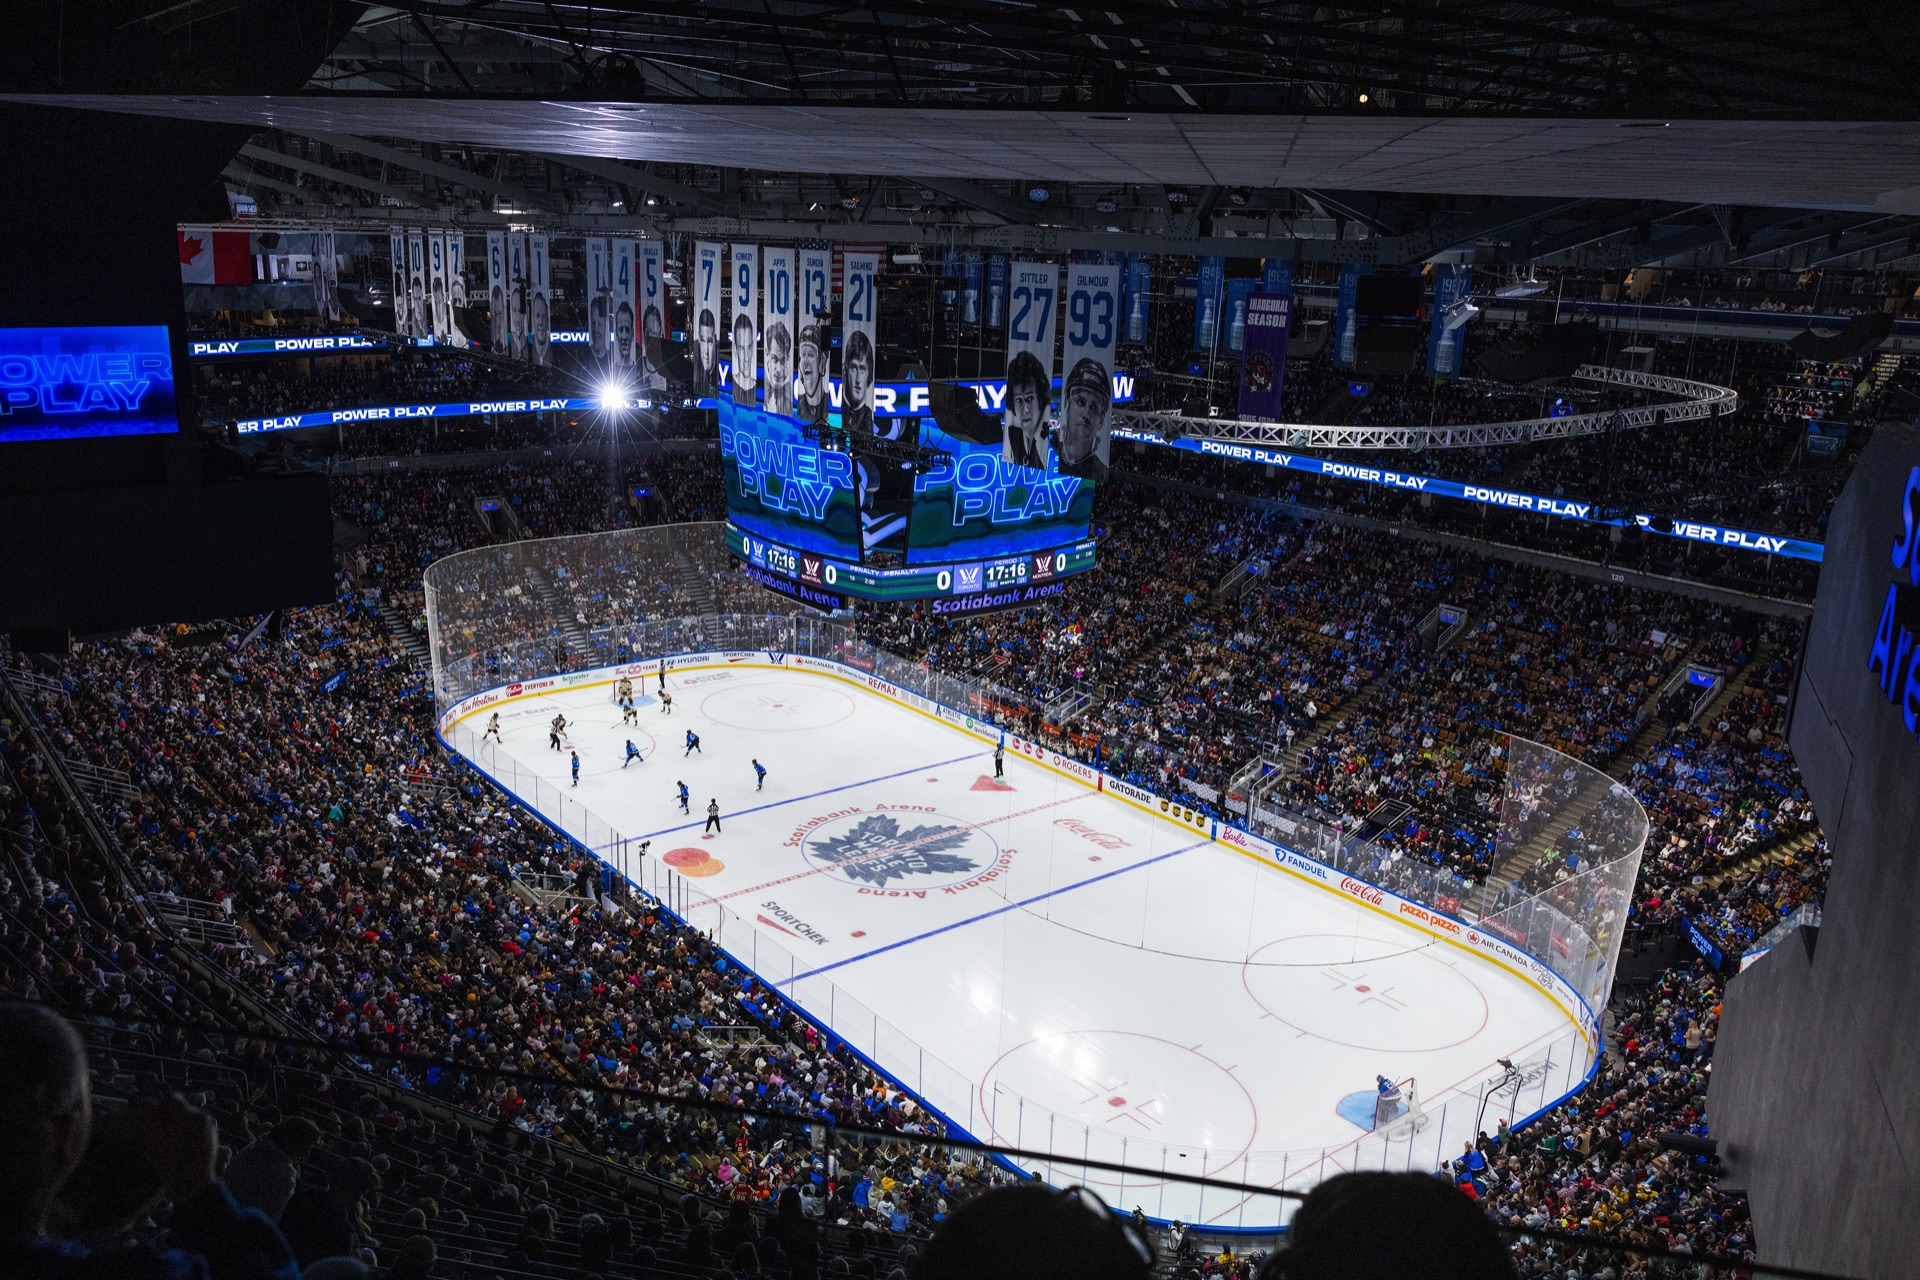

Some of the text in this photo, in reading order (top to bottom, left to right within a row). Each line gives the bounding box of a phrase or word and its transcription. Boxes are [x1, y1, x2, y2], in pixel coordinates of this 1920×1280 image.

[393, 238, 402, 265] 14
[411, 242, 421, 272] 10
[433, 241, 441, 272] 9
[451, 244, 459, 275] 7
[513, 248, 520, 278] 4
[735, 250, 753, 262] KENNEDY
[773, 258, 786, 268] APPS
[806, 258, 824, 268] SUNDIN
[492, 247, 501, 280] 6
[536, 251, 542, 286] 1
[594, 253, 600, 286] 1
[850, 261, 873, 272] SALMING
[618, 256, 629, 295] 4
[646, 259, 657, 297] 5
[702, 259, 713, 302] 7
[738, 263, 750, 307] 9
[1020, 272, 1048, 285] SITTLER
[1077, 276, 1109, 287] GILMOUR
[769, 270, 789, 315] 10
[804, 270, 825, 315] 13
[848, 273, 872, 323] 21
[1010, 286, 1053, 342] 27
[1249, 297, 1289, 313] INAUGURAL
[1068, 290, 1114, 348] 93
[1247, 313, 1287, 328] SEASON
[194, 342, 239, 354] PLAY
[275, 338, 334, 350] POWER
[338, 336, 376, 348] PLA
[0, 381, 150, 415] PLAY
[263, 416, 302, 430] PLAY
[332, 408, 390, 422] POWER
[394, 406, 436, 418] PLAY
[469, 401, 528, 414] POWER
[530, 399, 569, 411] PLAY
[718, 424, 854, 488] POWER
[738, 464, 833, 519] PLAY
[953, 477, 1082, 526] PLAY
[1202, 441, 1252, 461] POWER
[1254, 451, 1292, 467] PLAY
[1321, 461, 1381, 481] POWER
[1384, 471, 1428, 490] PLAY
[1463, 485, 1533, 511] POWER
[1536, 498, 1590, 521] PLAY
[1634, 515, 1717, 541] PWER
[1723, 530, 1787, 552] PLAY
[1389, 527, 1399, 536] 119
[743, 536, 750, 555] 0
[771, 543, 788, 553] PERIOD
[1075, 541, 1095, 551] PENALTY
[767, 549, 796, 570] 17:16
[849, 564, 880, 577] PENALTY
[994, 558, 1018, 566] PERIOD
[1056, 553, 1066, 571] 0
[825, 564, 837, 585] 0
[864, 578, 876, 586] 2:00
[883, 568, 920, 577] PENALTY
[936, 571, 951, 590] 0
[987, 563, 1026, 581] 17:16
[1611, 574, 1625, 583] 120
[744, 562, 840, 609] Scotiabank Arena
[957, 583, 980, 591] TORONTO
[932, 582, 1064, 614] Scotiabank Arena
[677, 656, 710, 665] HYUNDAI
[804, 659, 834, 670] AIR CANADA
[524, 681, 548, 691] EVERYONE
[562, 673, 590, 685] Schneider
[868, 676, 897, 697] RE/MAX
[460, 694, 499, 714] Tim Hortons
[973, 726, 999, 742] quickbooks
[1062, 758, 1092, 780] ROGERS
[1109, 780, 1152, 804] GATORADE
[783, 803, 937, 848] Scotiabank Arena
[1223, 825, 1248, 847] Barbie
[837, 845, 888, 873] LEFS
[1288, 855, 1328, 880] FANDUEL
[856, 848, 1018, 900] Scotiabank Arena
[761, 900, 831, 946] SPORTCHEK
[1399, 902, 1460, 935] pizza pizza
[1690, 926, 1713, 954] POWER
[1691, 937, 1709, 956] PLAY
[1481, 938, 1528, 968] AIR CANADA
